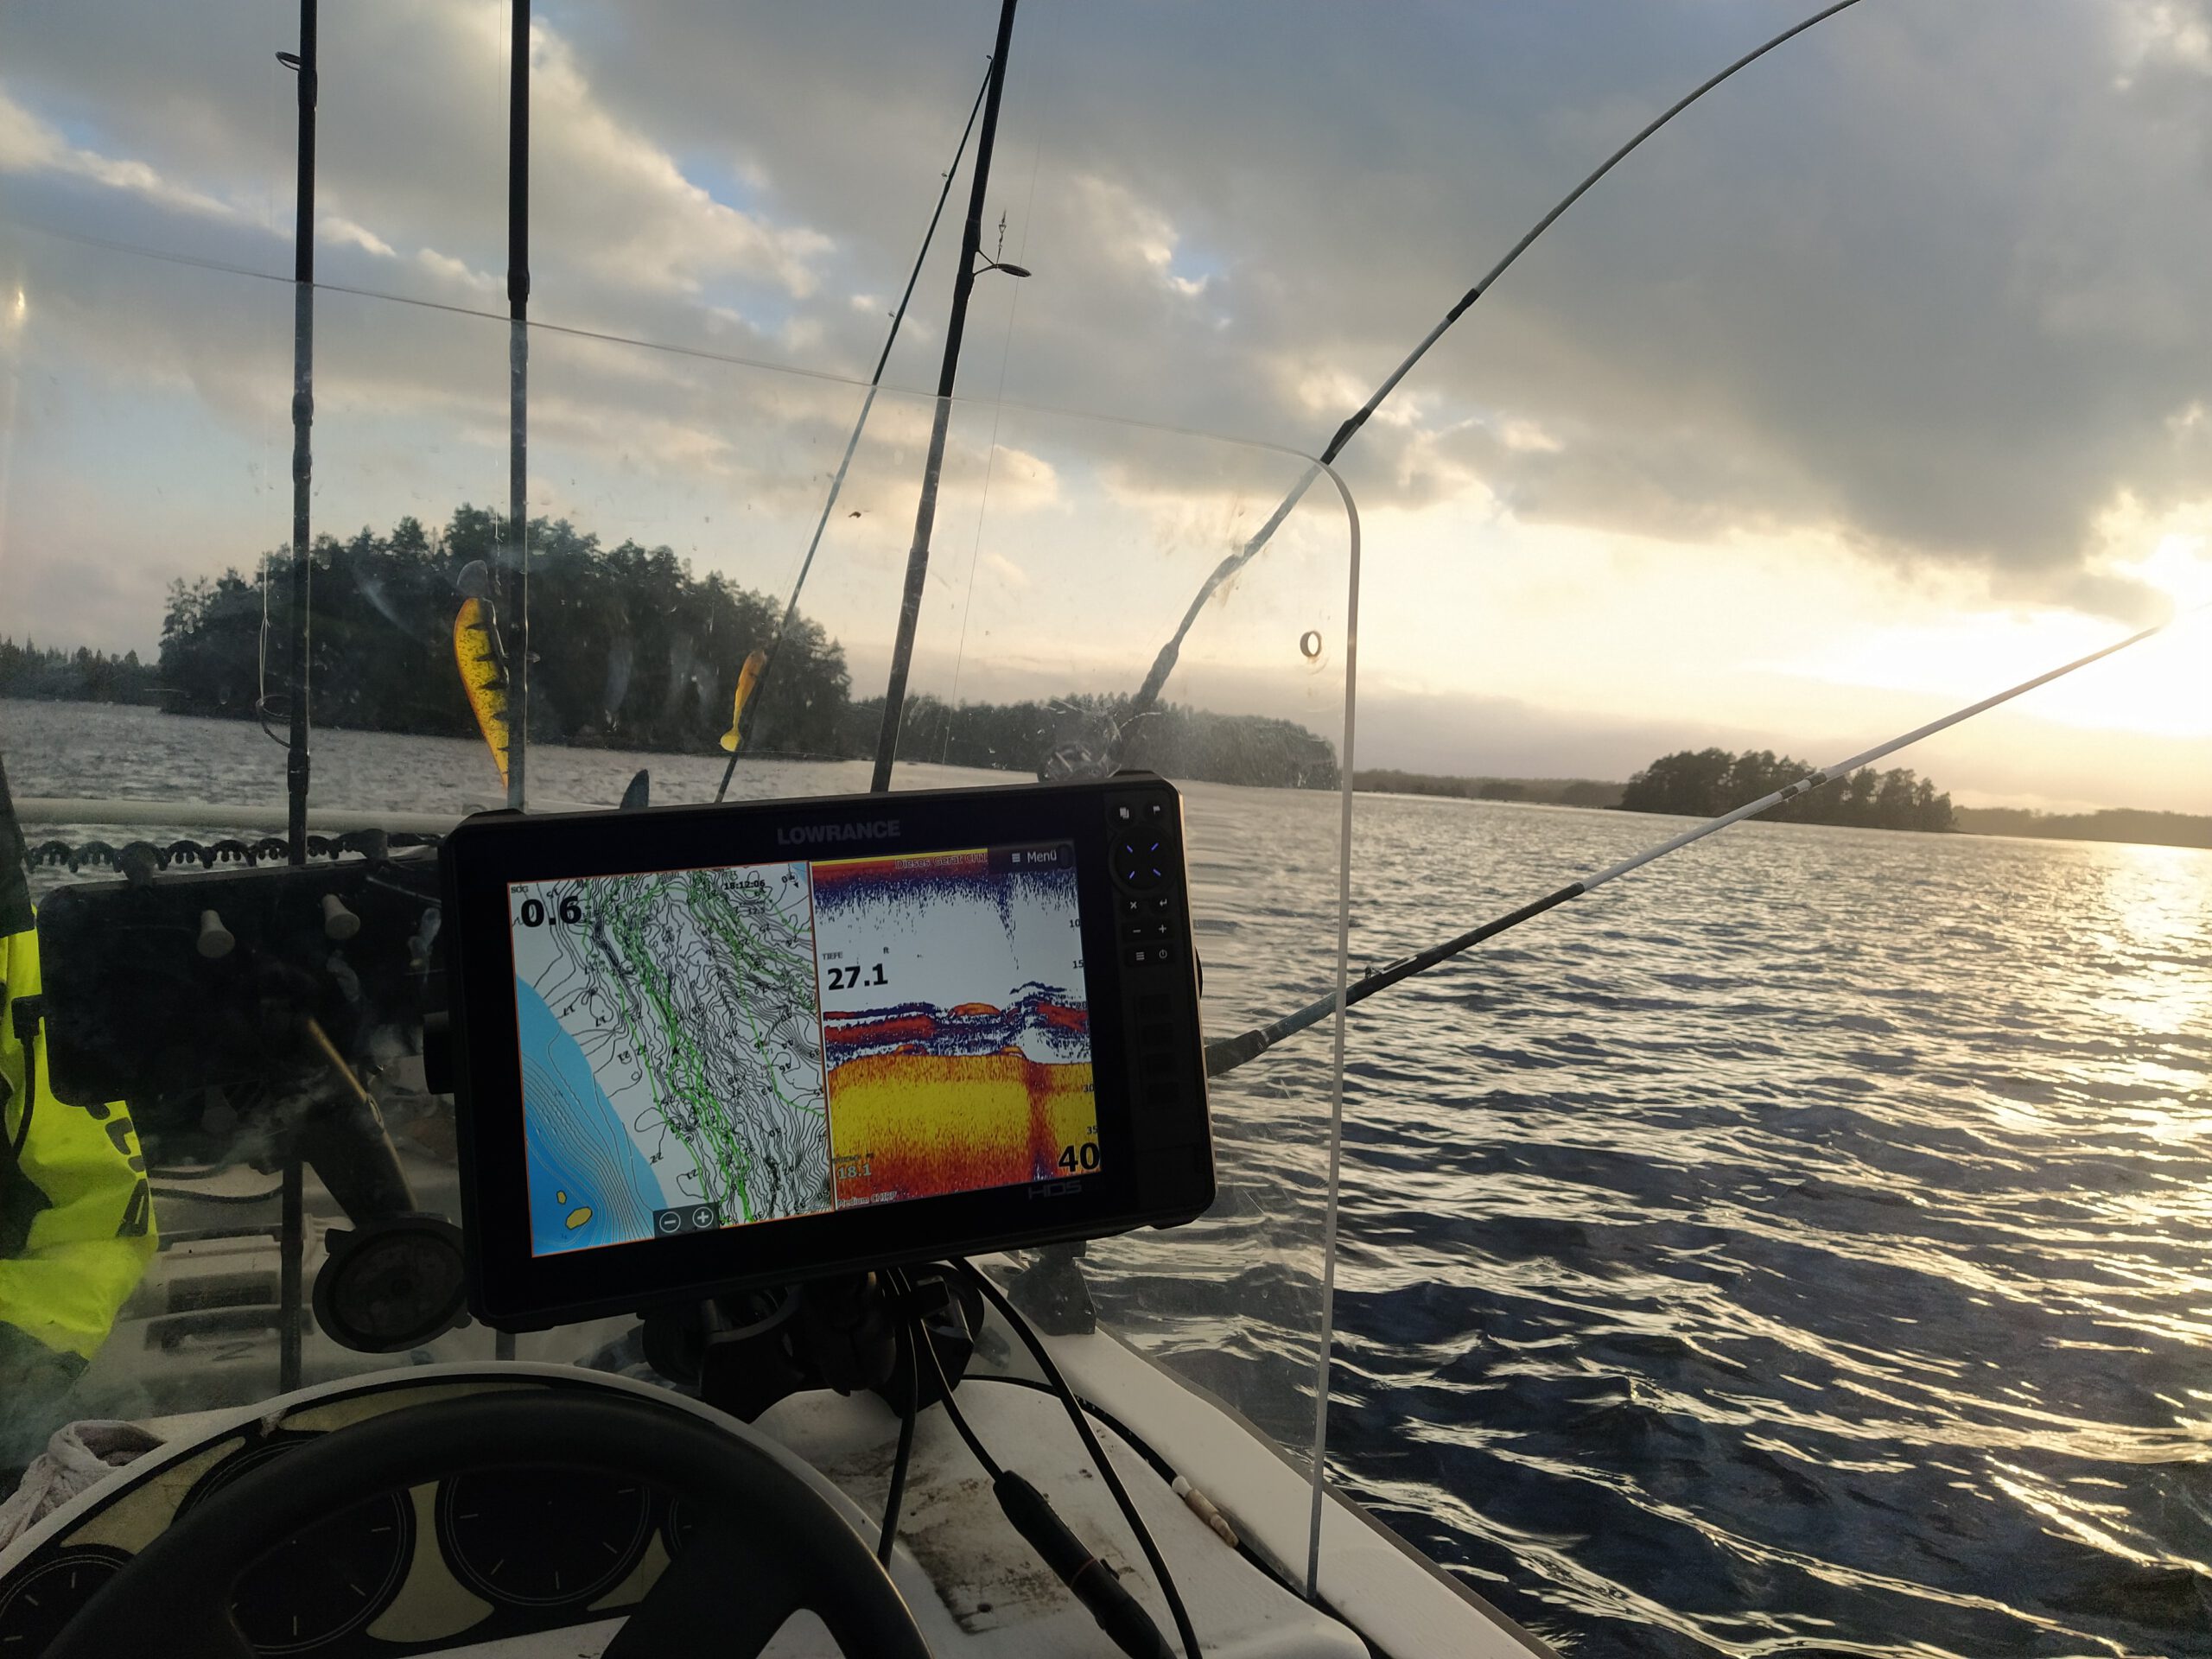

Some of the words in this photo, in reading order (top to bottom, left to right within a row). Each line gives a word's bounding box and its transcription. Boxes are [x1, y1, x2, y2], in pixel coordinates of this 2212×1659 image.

[778, 820, 901, 845] LOWRANCE
[1027, 850, 1058, 863] Menü
[895, 858, 931, 870] Dieses
[511, 885, 529, 893] SOG
[724, 880, 766, 890] 18:12:06
[520, 895, 582, 928] 0.6
[1070, 918, 1080, 928] 10
[823, 951, 843, 961] TIEFE
[1072, 959, 1084, 969] 15
[827, 963, 888, 991] 27.1
[1083, 1084, 1095, 1093] 30
[1086, 1126, 1098, 1135] 35
[1058, 1141, 1101, 1173] 40
[837, 1162, 872, 1180] 18.1
[1028, 1179, 1083, 1200] HDS
[837, 1196, 870, 1209] Medium
